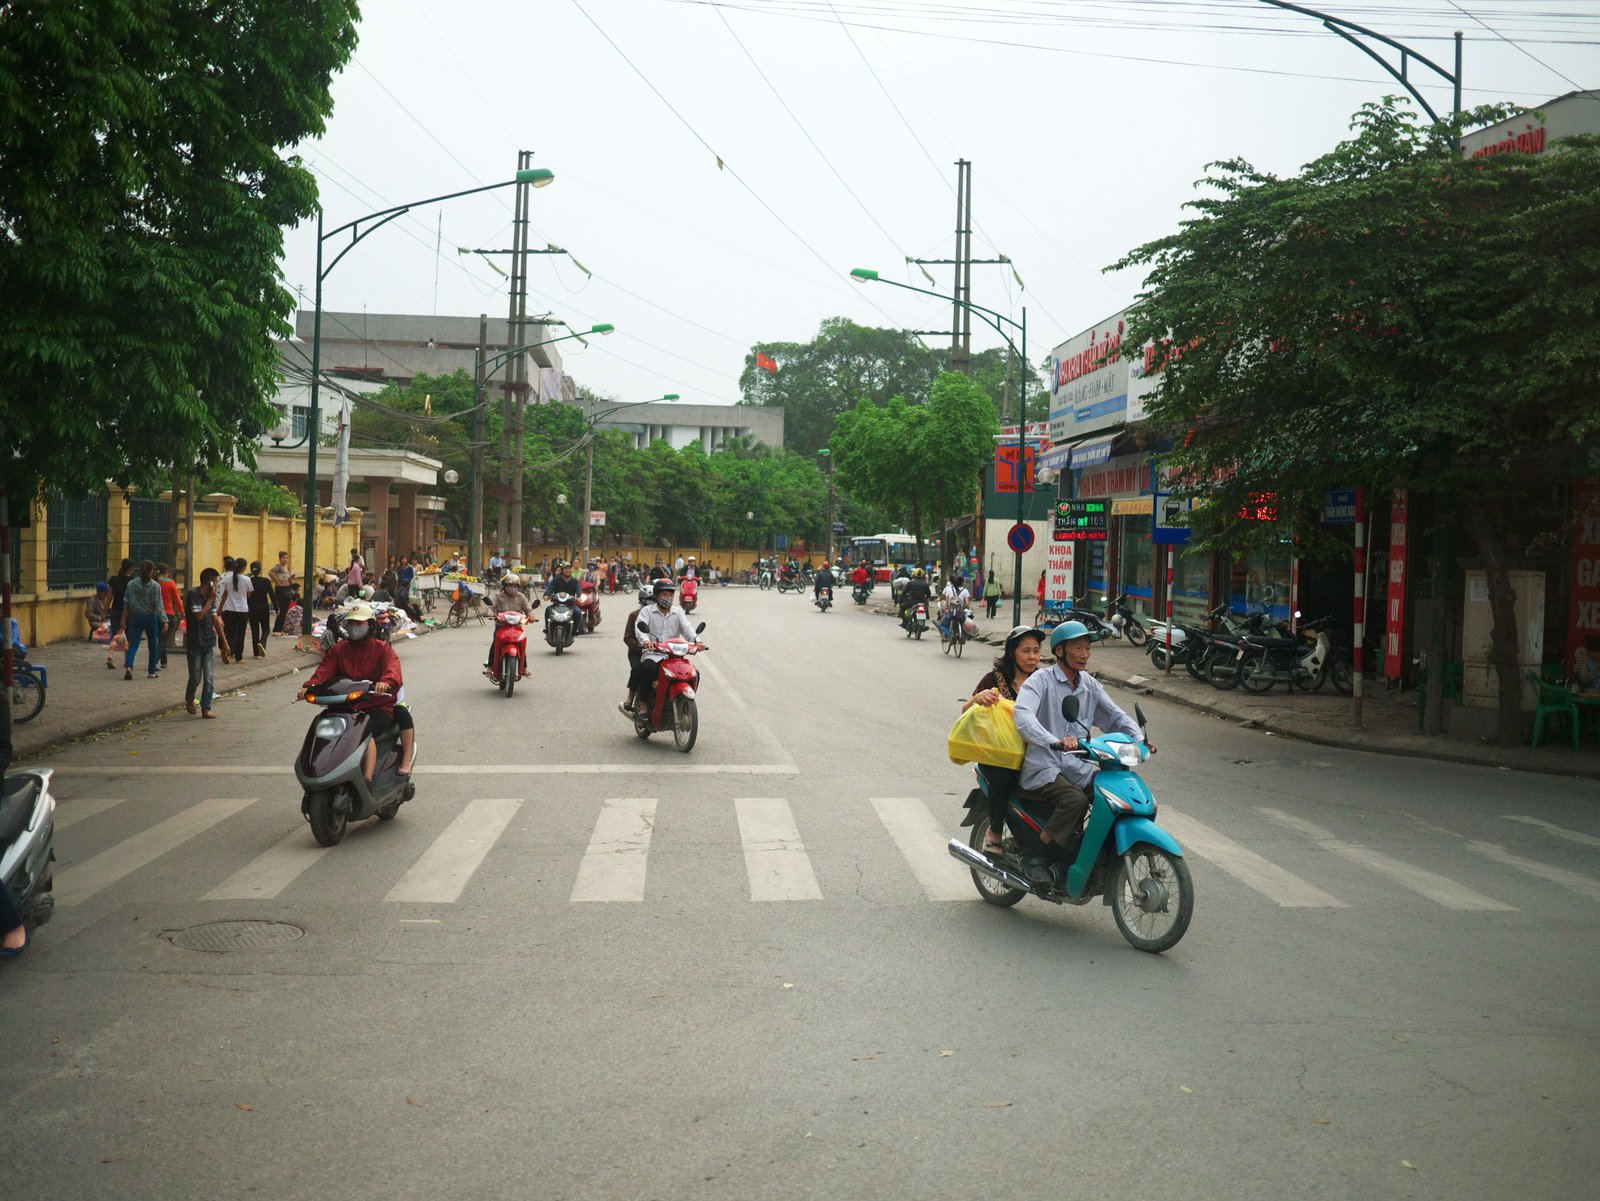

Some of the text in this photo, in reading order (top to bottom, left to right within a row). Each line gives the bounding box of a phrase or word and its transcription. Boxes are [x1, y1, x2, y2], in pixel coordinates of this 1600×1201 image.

[1091, 472, 1107, 496] KHOA
[1072, 503, 1085, 511] NHA
[1049, 545, 1072, 555] KHOA
[1048, 556, 1072, 570] THẨM
[1053, 573, 1066, 585] MỸ
[1052, 590, 1066, 599] 108
